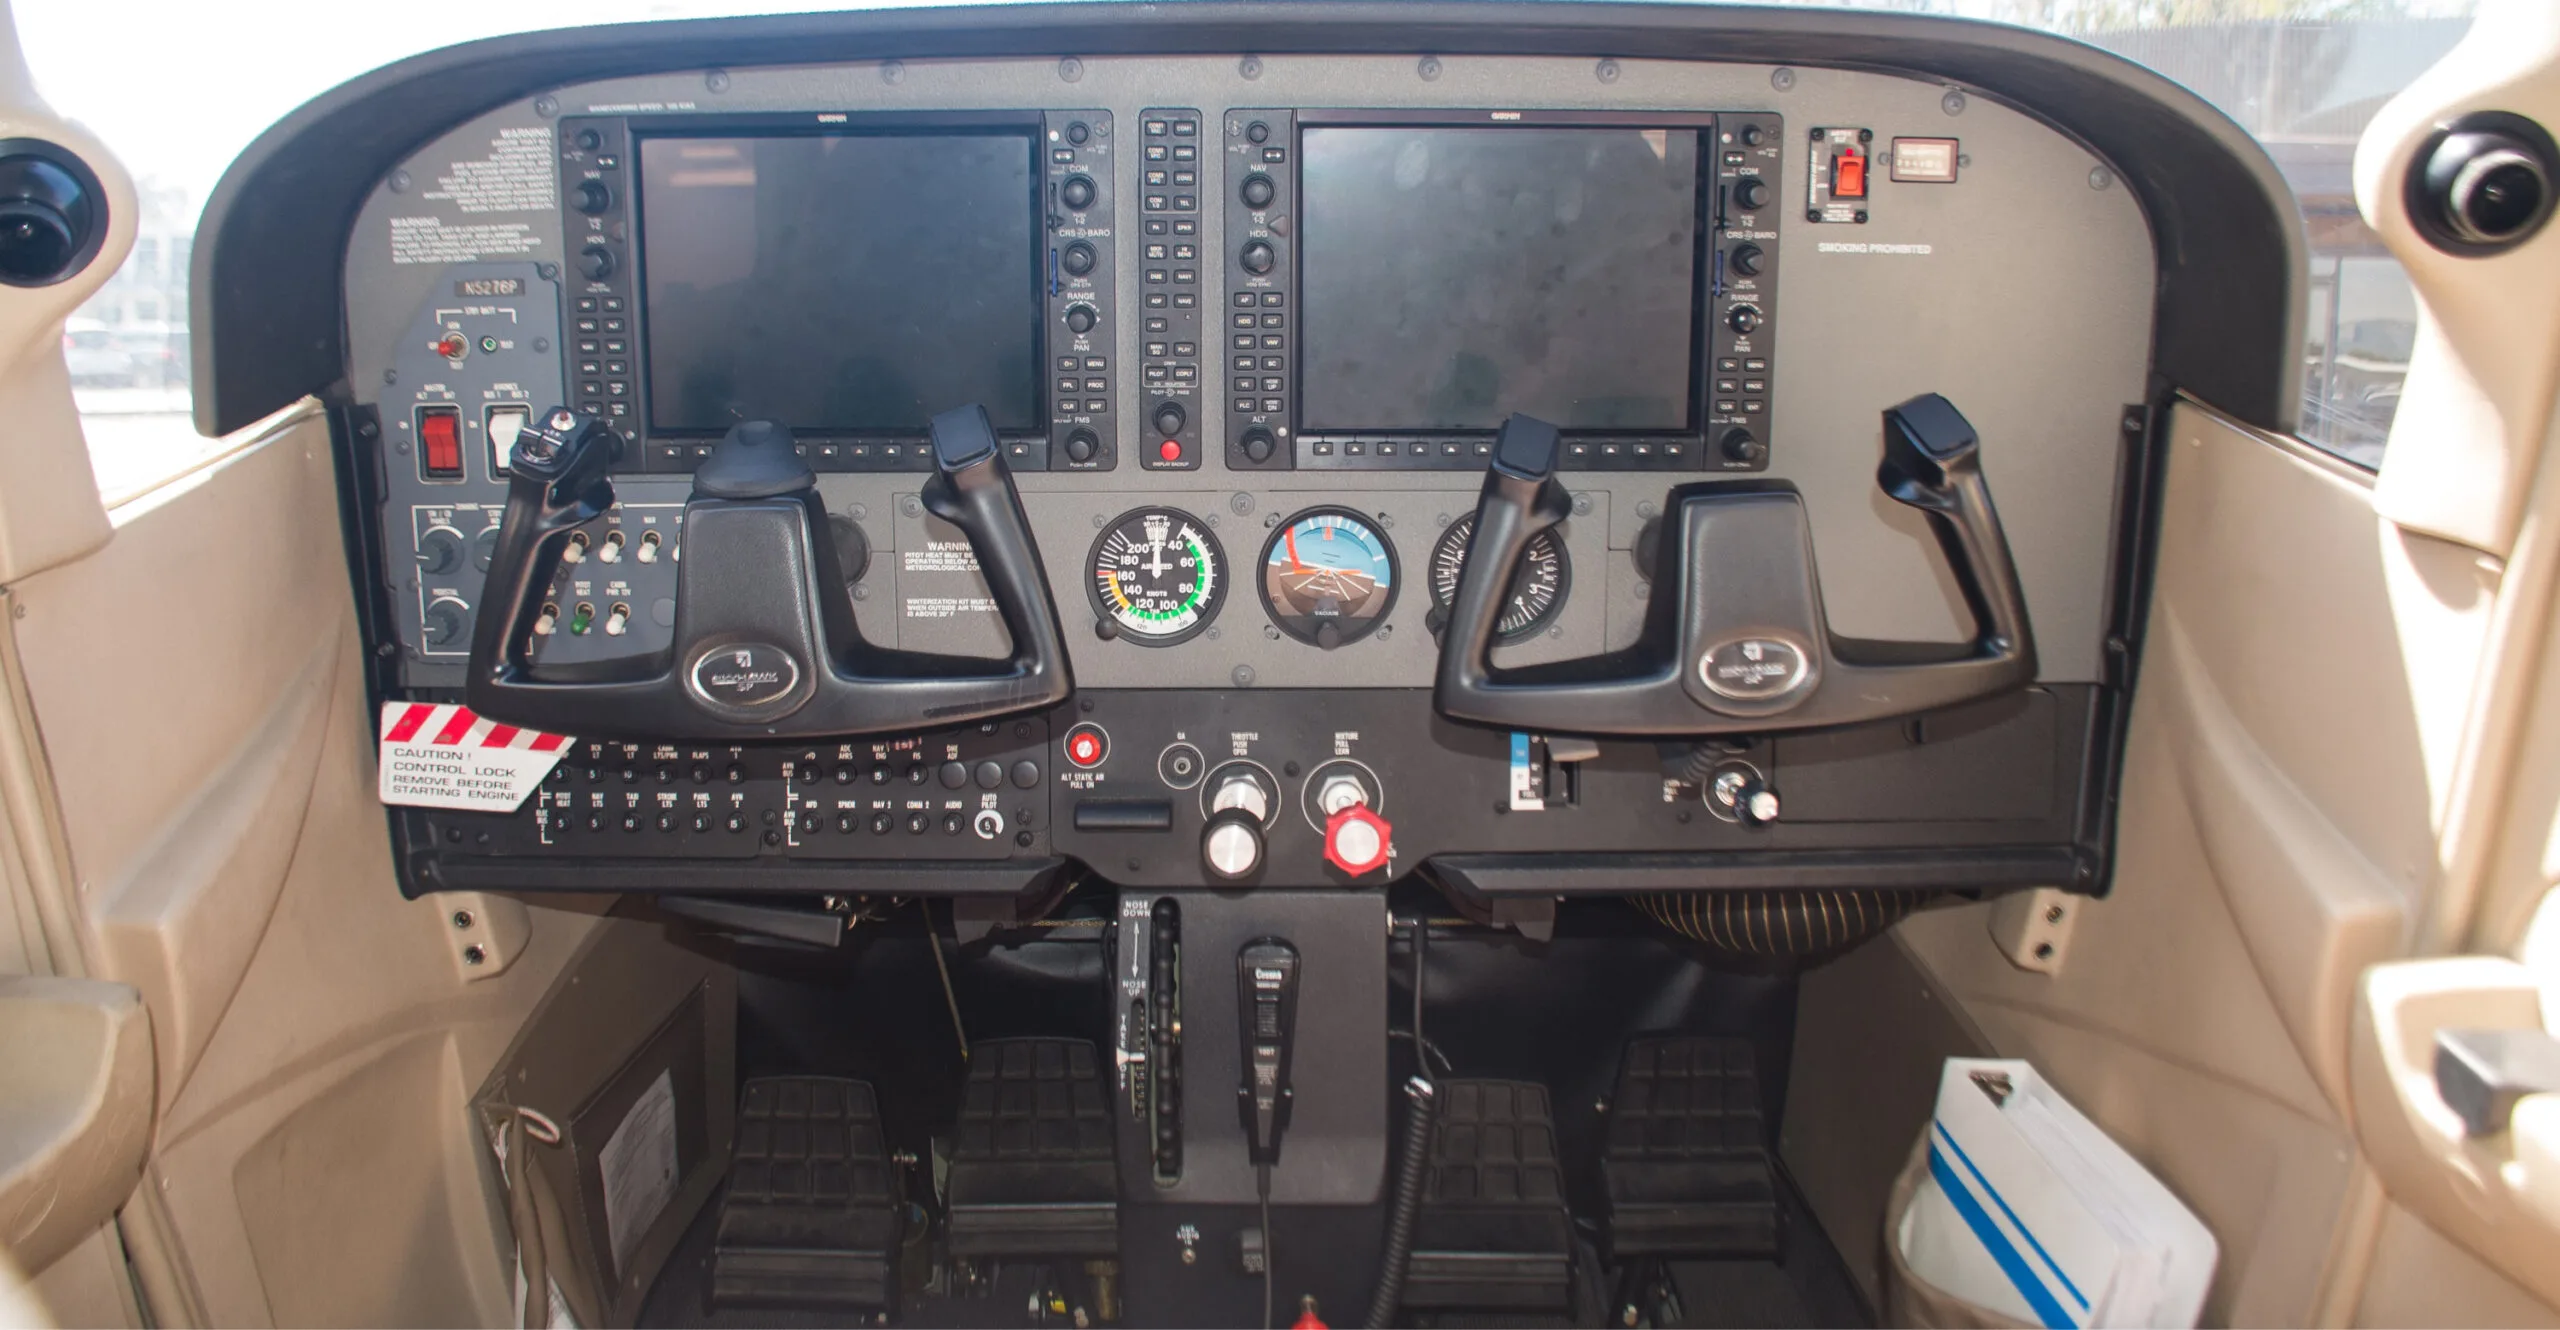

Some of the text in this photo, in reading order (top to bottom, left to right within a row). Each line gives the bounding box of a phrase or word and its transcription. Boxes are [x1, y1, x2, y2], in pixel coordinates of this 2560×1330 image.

[1069, 164, 1088, 173] COM
[1250, 164, 1266, 172] NAV
[1740, 168, 1759, 176] COM
[1059, 229, 1110, 238] CRS BARO
[1250, 230, 1267, 238] HDG
[1727, 232, 1777, 240] CRS BARO
[1818, 243, 1932, 254] SMOKING PROHIBITED
[1067, 292, 1095, 300] RANGE
[1731, 294, 1759, 302] RANGE
[1074, 344, 1090, 352] PAN
[1734, 345, 1750, 353] PAN
[1075, 417, 1090, 425] FMS
[1252, 416, 1266, 424] ALT
[927, 542, 972, 551] WARNIN
[1127, 543, 1149, 553] 200
[1168, 540, 1183, 550] 40
[1120, 555, 1138, 565] 180
[1180, 557, 1194, 567] 60
[1141, 563, 1173, 571] AIREED
[1118, 571, 1135, 581] 160
[1124, 585, 1142, 594] 140
[1179, 583, 1193, 593] 80
[1529, 583, 1538, 594] 3
[1136, 599, 1154, 608] 120
[1514, 596, 1523, 605] 4
[1160, 600, 1178, 610] 100
[1232, 732, 1258, 740] THROTTLE
[1335, 732, 1359, 740] MIXTURE
[623, 744, 638, 752] LAND
[1233, 741, 1247, 749] PUSH
[1335, 740, 1349, 748] PULL
[394, 748, 463, 760] CAUTION
[627, 752, 635, 760] LT
[692, 752, 709, 760] FLAPS
[1233, 748, 1247, 756] OPEN
[1335, 748, 1350, 756] LEAN
[393, 762, 516, 777] CONTROL LOCK
[555, 769, 563, 778] 5
[589, 770, 596, 779] 5
[805, 771, 812, 780] 5
[838, 772, 846, 780] 10
[874, 771, 882, 780] 15
[912, 772, 919, 781] 5
[1061, 773, 1104, 781] ALT STATIC AIR
[393, 775, 513, 790] REMOVE BEFORE
[1070, 781, 1094, 789] PULL ON
[392, 786, 519, 801] STARTING ENGINE
[693, 793, 710, 801] PANEL
[982, 793, 997, 801] AUTO
[696, 801, 707, 809] LTS
[873, 800, 884, 808] NAV
[907, 800, 930, 809] COMM 2
[945, 800, 962, 809] AUDIO
[981, 801, 997, 809] PILOT
[557, 819, 565, 828] 5
[591, 819, 598, 828] 5
[626, 820, 634, 828] 10
[661, 819, 669, 827] 5
[695, 819, 703, 828] 5
[730, 820, 737, 828] 15
[806, 820, 812, 829] 5
[841, 820, 848, 829] 5
[876, 821, 883, 830] 5
[912, 821, 919, 830] 5
[949, 821, 956, 830] 5
[984, 821, 991, 830] 5
[1125, 901, 1148, 909] NOSE
[1123, 909, 1150, 917] DOWN
[1122, 981, 1146, 989] NOSE
[1129, 988, 1140, 996] UP
